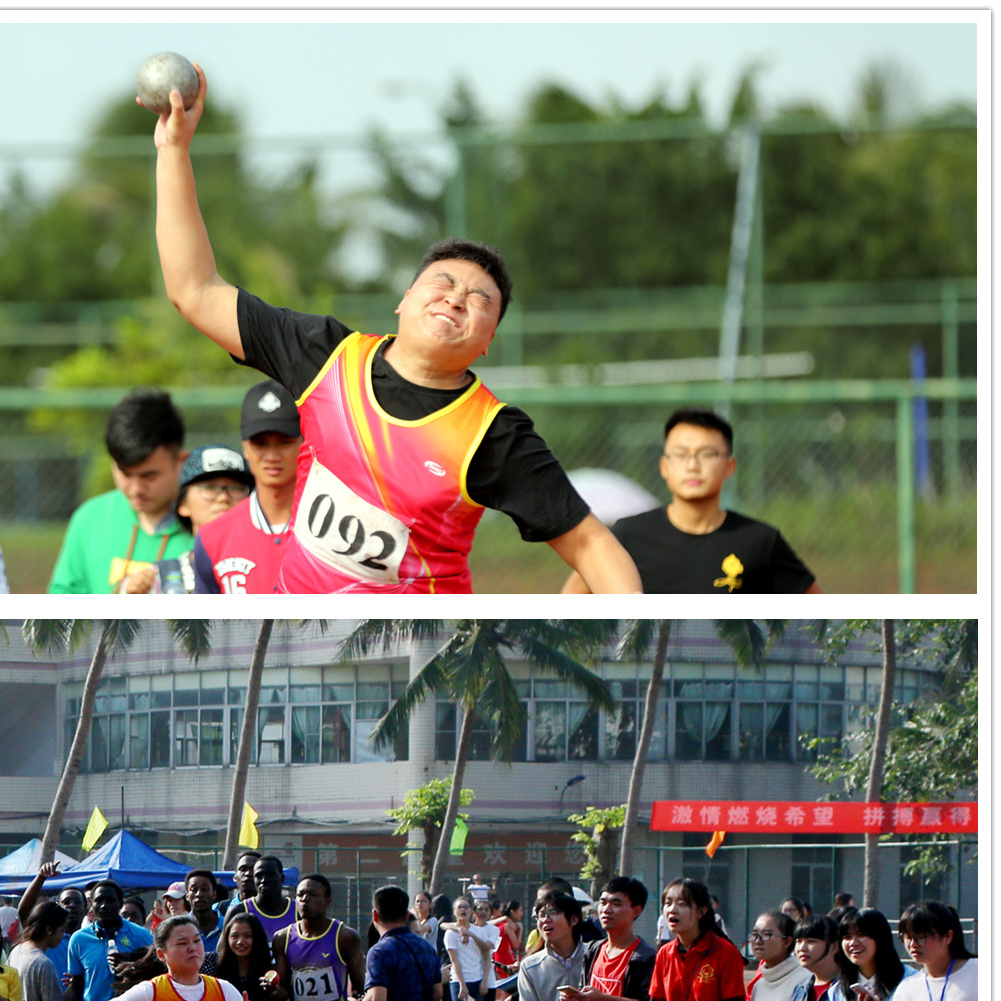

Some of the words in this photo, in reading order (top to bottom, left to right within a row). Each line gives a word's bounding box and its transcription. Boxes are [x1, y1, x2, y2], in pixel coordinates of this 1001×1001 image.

[307, 493, 397, 572] 092
[671, 805, 835, 826] 激情燃烧希望
[863, 806, 972, 826] 拼搏赢得
[295, 973, 335, 997] 021
